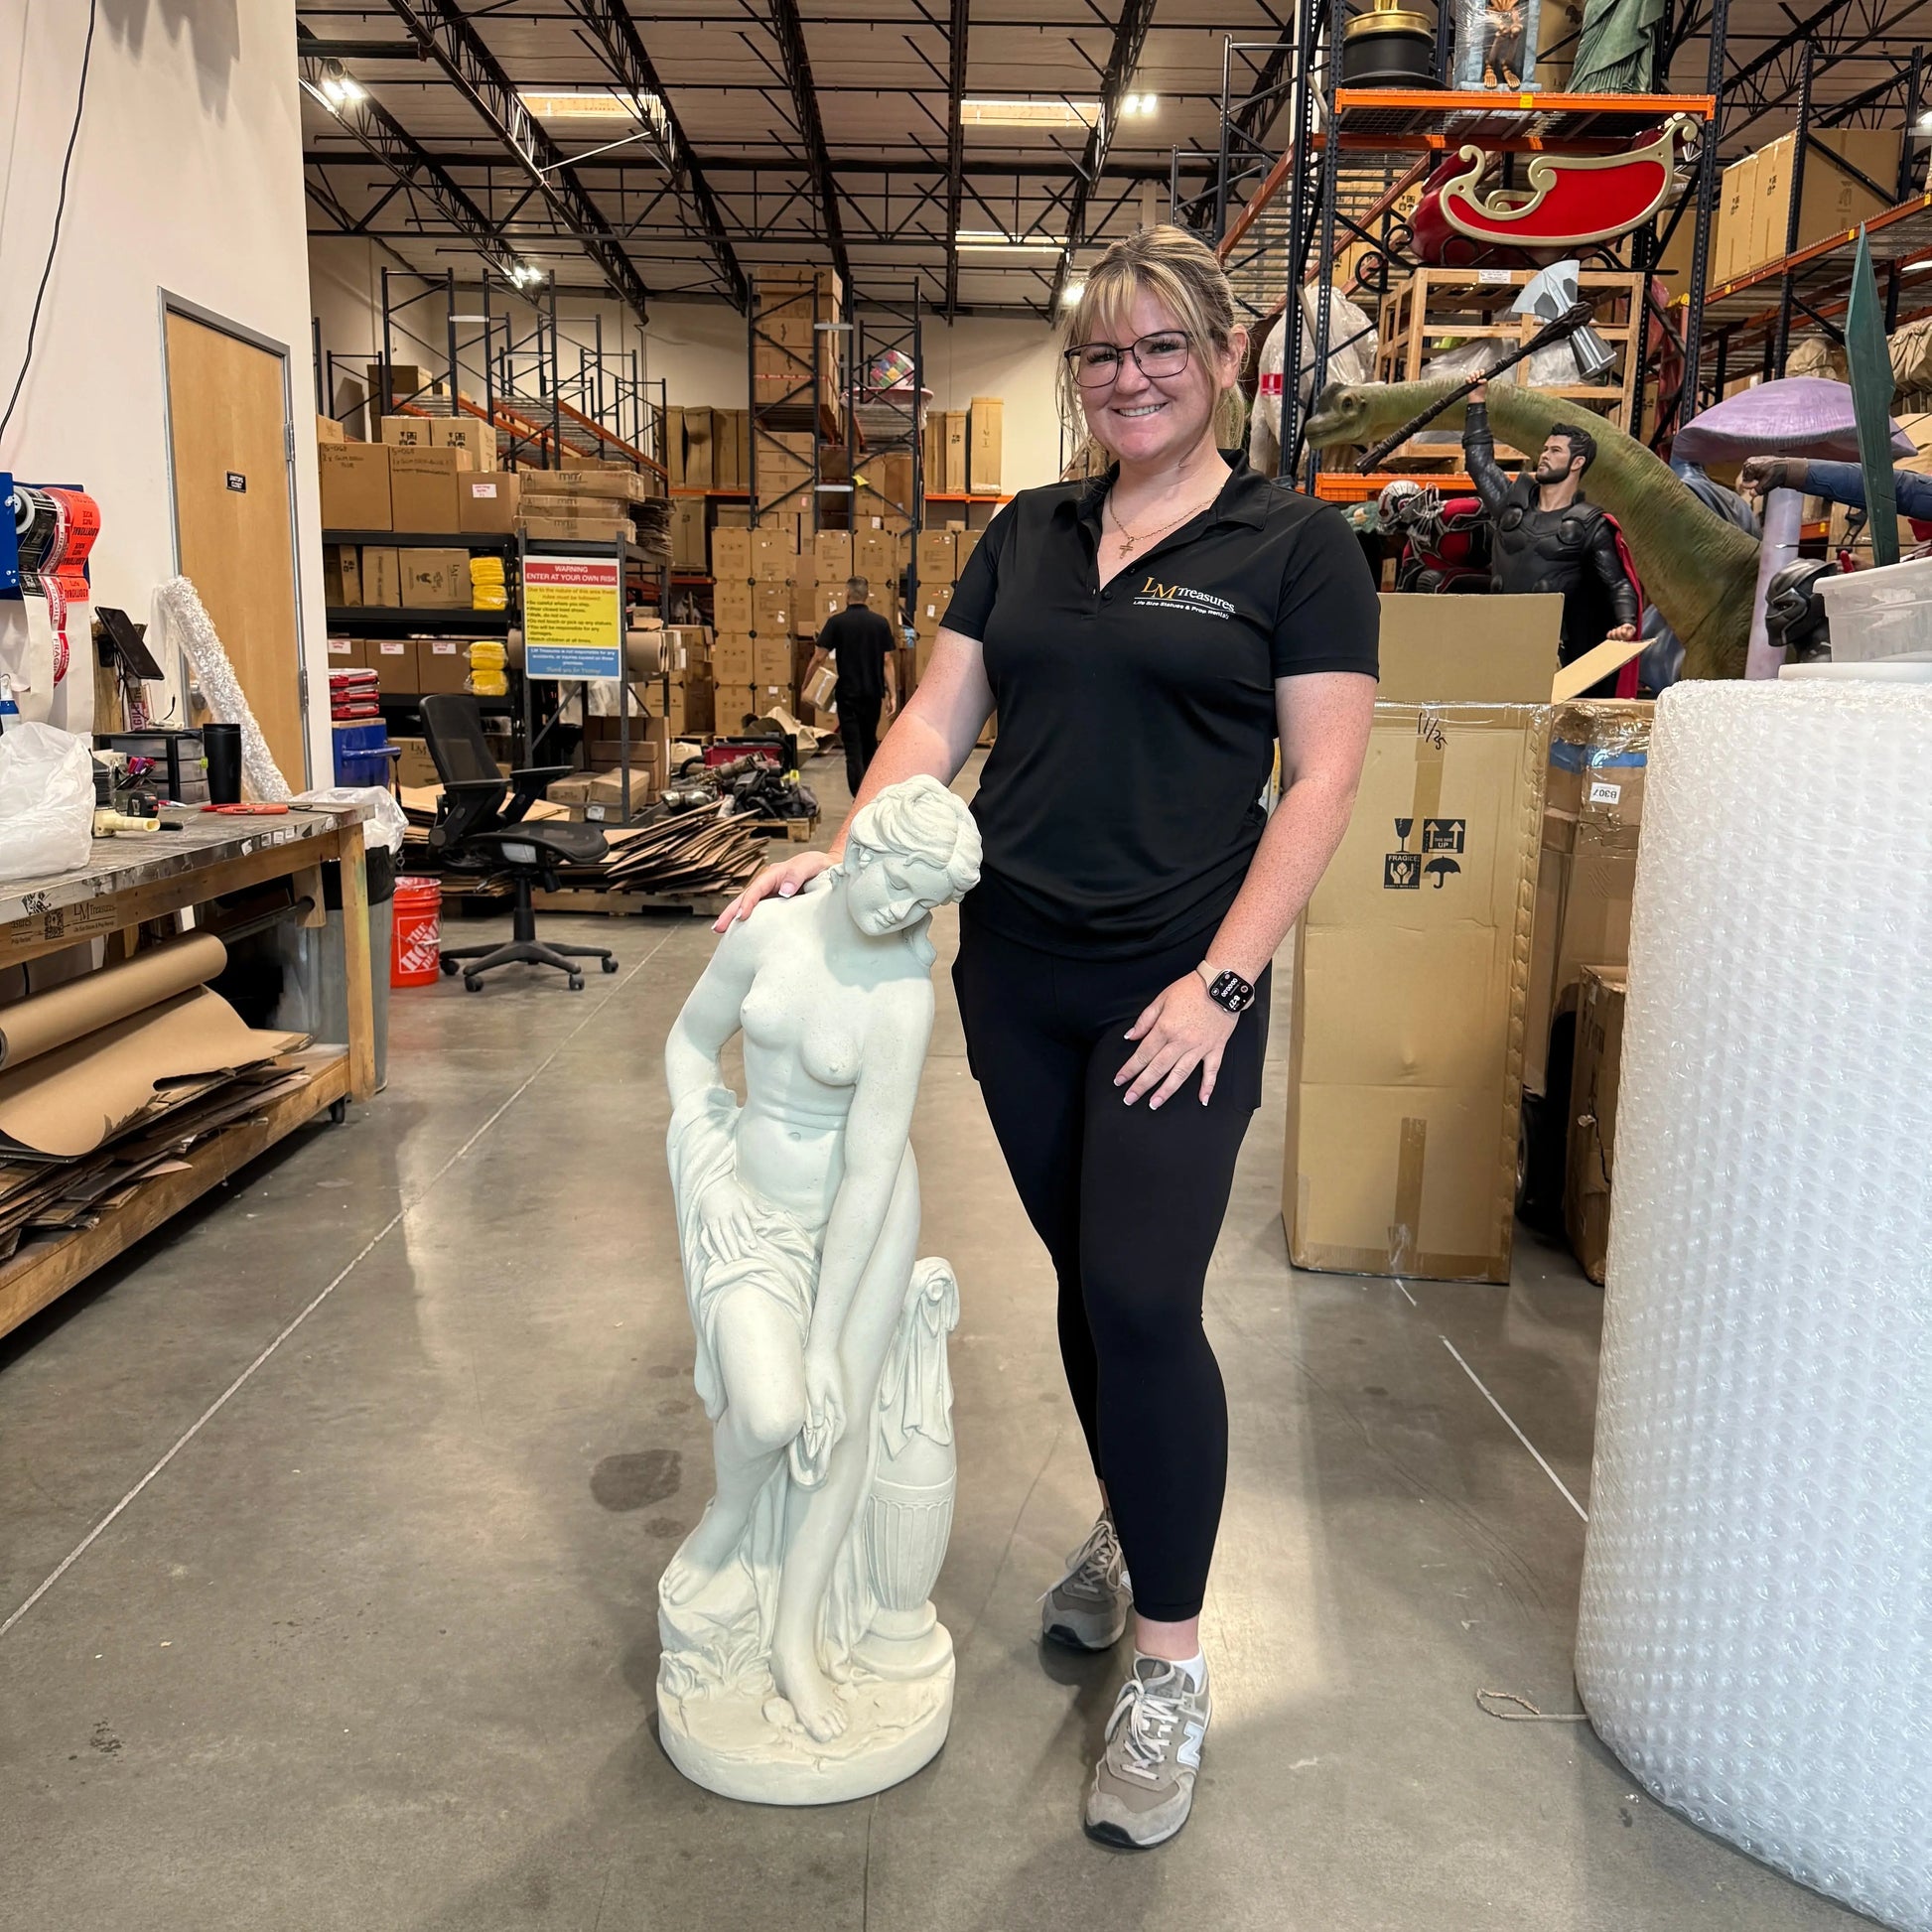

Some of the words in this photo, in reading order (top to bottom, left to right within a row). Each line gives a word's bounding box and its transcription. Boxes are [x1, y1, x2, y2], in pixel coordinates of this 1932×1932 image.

[50, 583, 60, 624] FRAGILE
[1140, 576, 1180, 600] LM
[1177, 587, 1236, 613] Treasures
[1190, 606, 1207, 615] Prop
[131, 702, 143, 732] AGILE
[1592, 788, 1617, 799] B307
[1176, 1721, 1205, 1770] N
